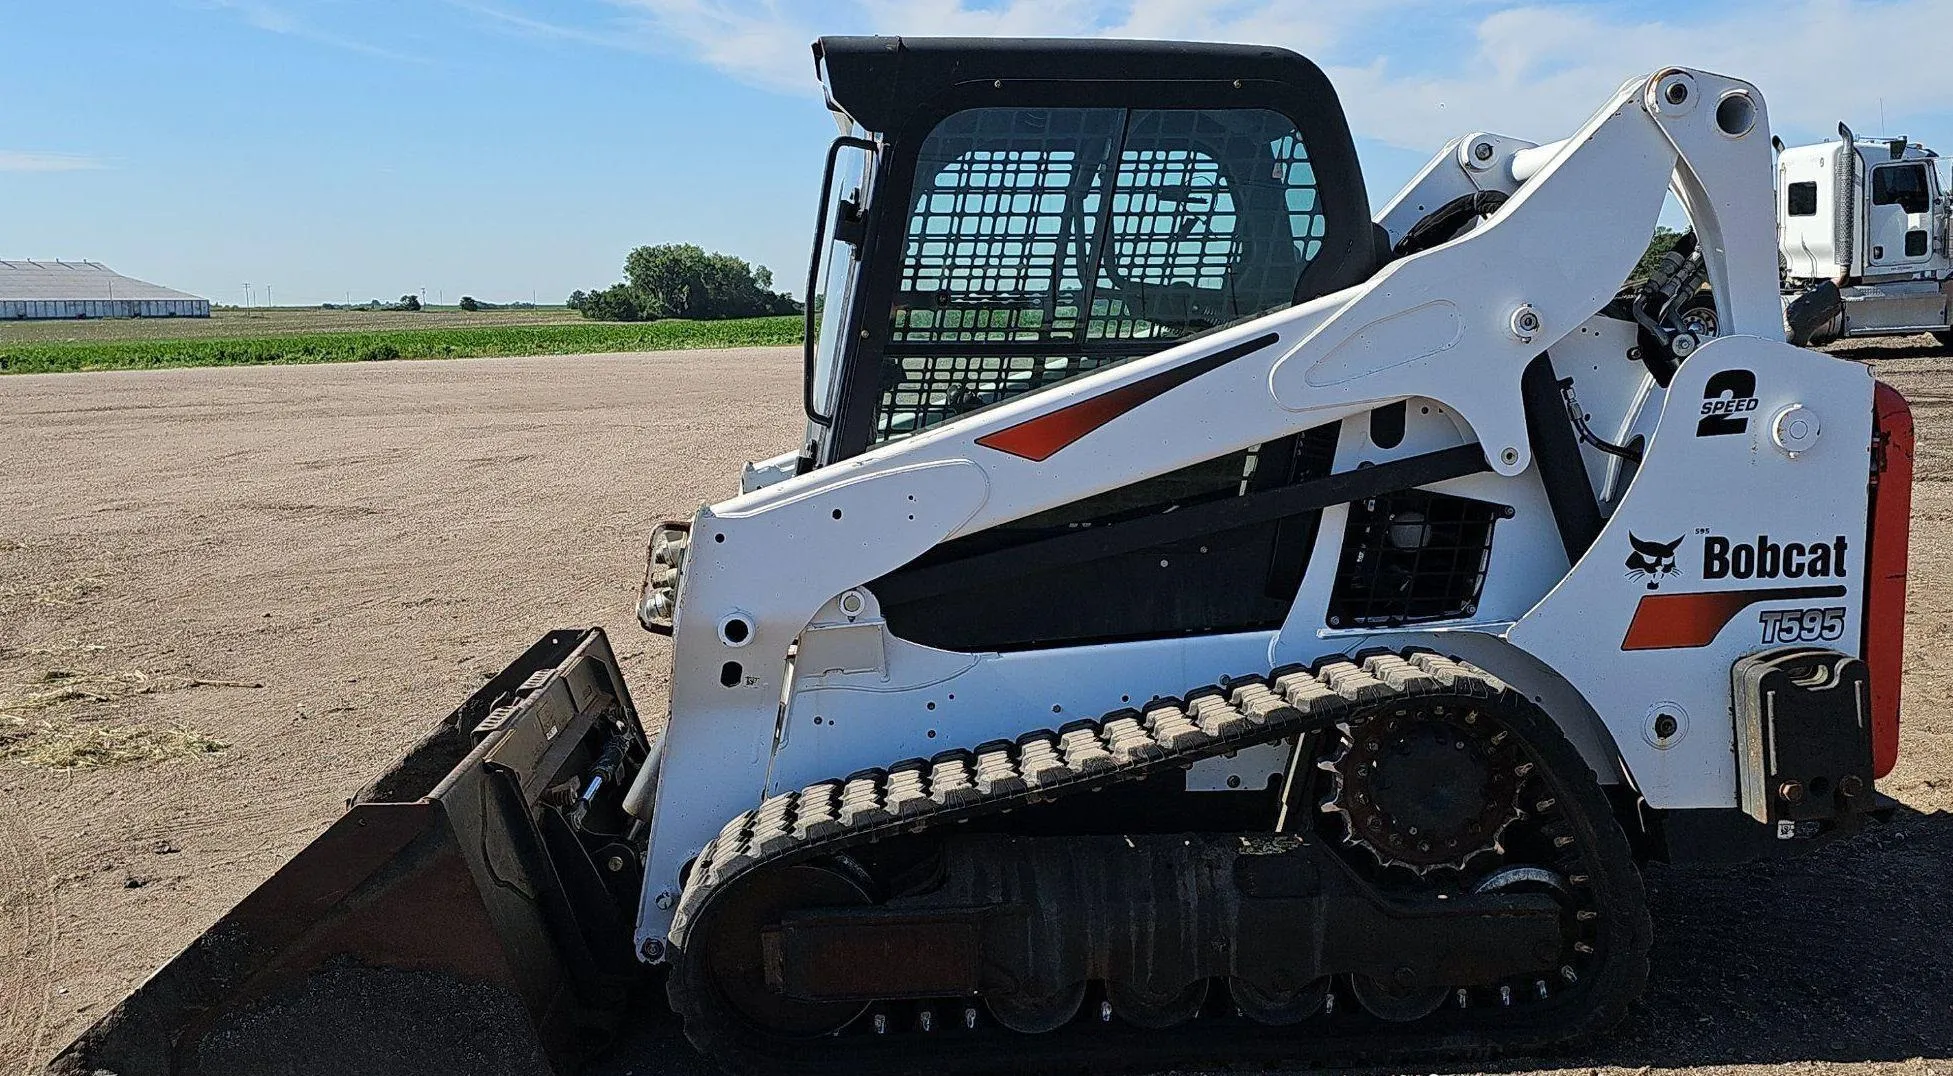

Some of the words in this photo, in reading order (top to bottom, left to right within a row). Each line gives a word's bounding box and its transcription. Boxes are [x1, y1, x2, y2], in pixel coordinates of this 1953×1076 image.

[1696, 369, 1756, 437] 2
[1701, 398, 1759, 415] SPEED
[1703, 535, 1848, 580] Bobcat
[1759, 607, 1847, 644] T595
